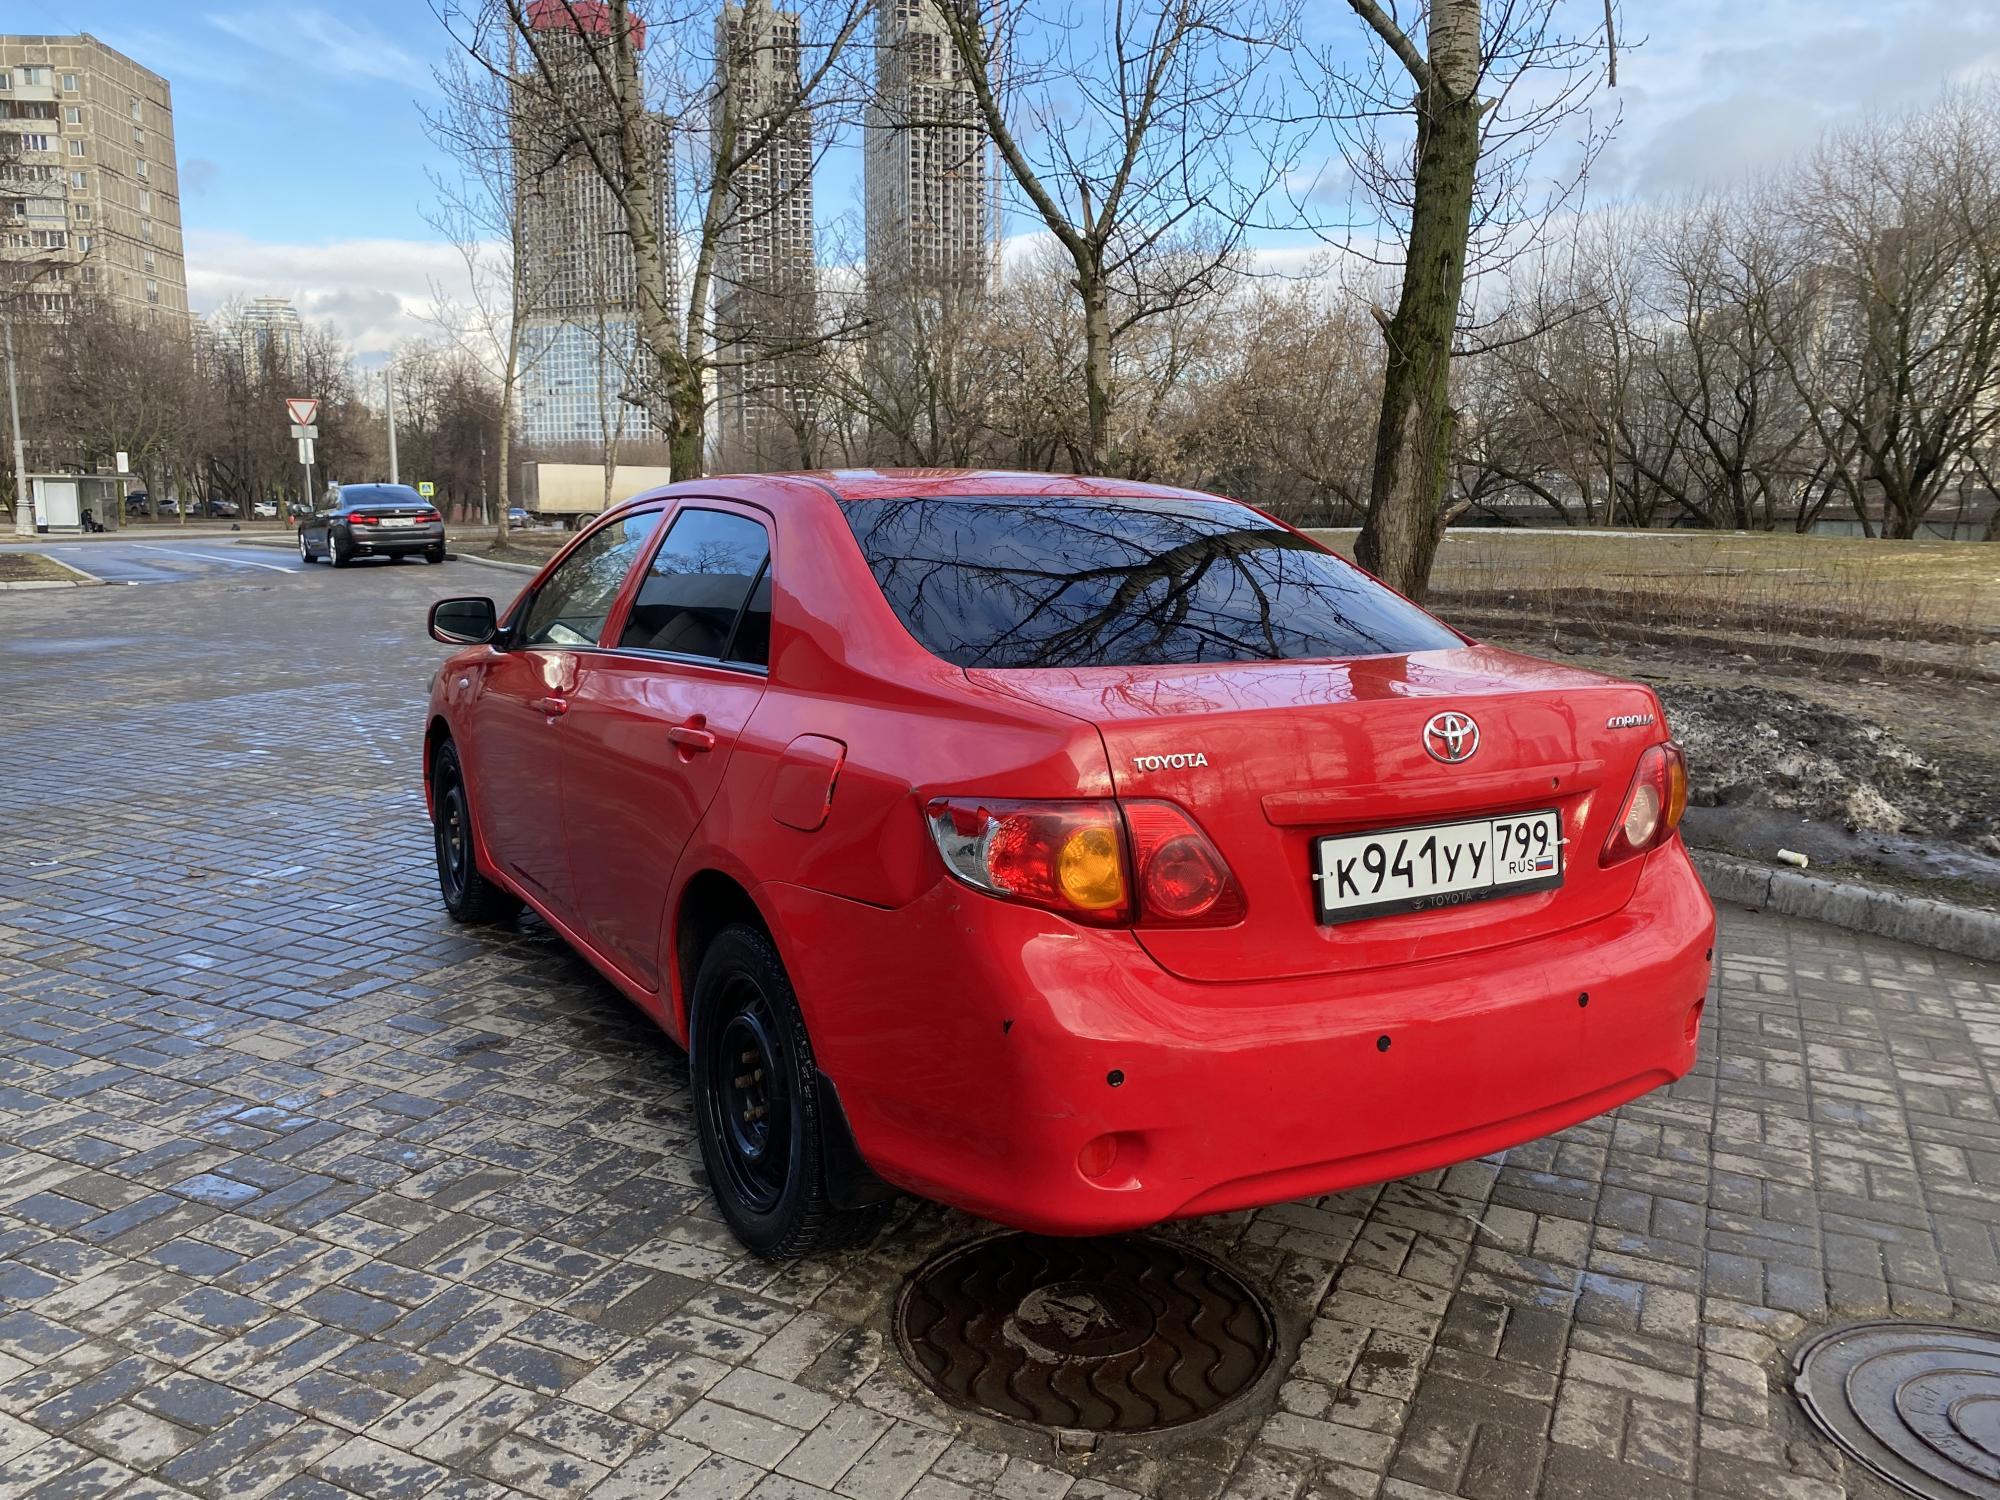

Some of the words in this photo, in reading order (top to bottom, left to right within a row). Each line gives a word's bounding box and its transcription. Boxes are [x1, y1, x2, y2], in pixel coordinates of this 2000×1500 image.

[1133, 752, 1208, 773] TOYOTA
[1496, 820, 1549, 862] 799
[1509, 860, 1535, 875] RUS
[1429, 890, 1473, 906] TOYOTA
